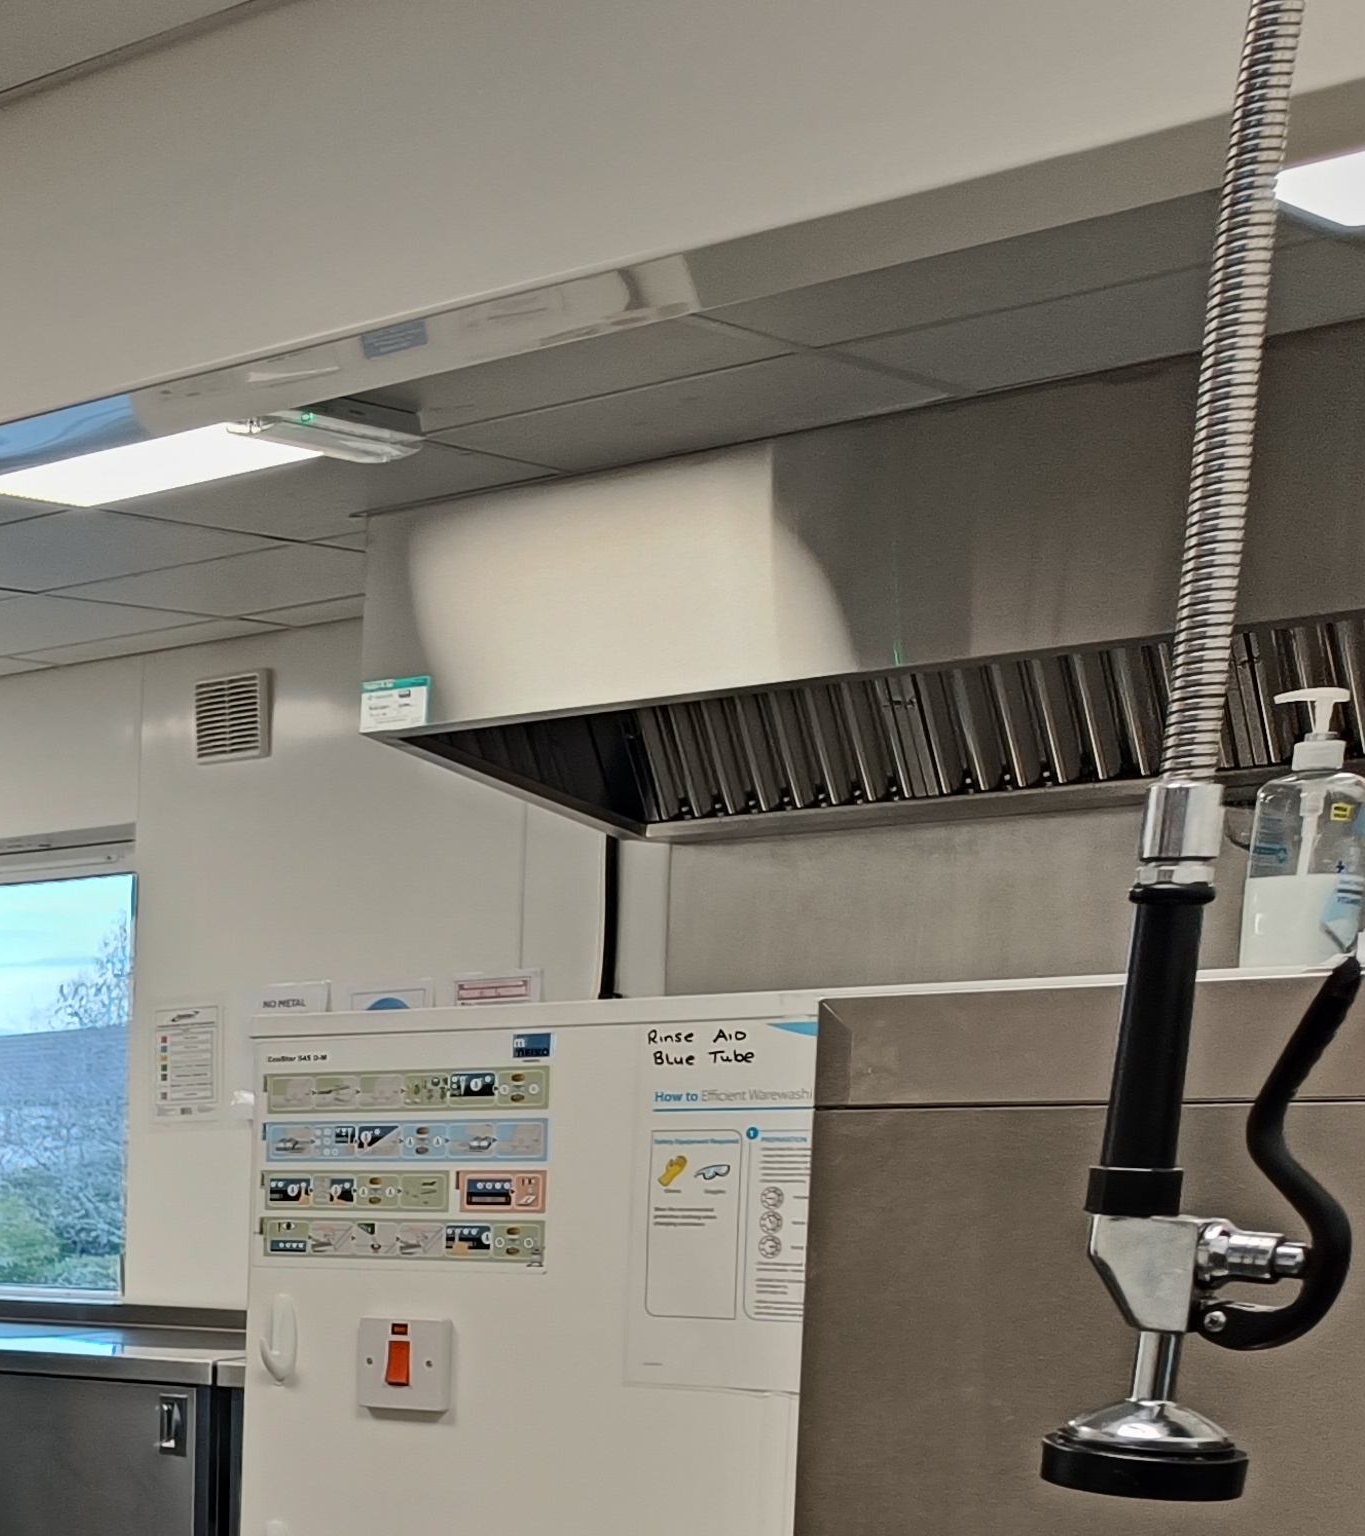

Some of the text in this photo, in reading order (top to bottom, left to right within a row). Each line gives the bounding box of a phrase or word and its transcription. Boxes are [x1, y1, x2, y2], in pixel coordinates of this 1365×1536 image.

[262, 1000, 277, 1008] NO
[647, 1029, 694, 1045] Rinse
[708, 1049, 755, 1064] Tube
[655, 1091, 683, 1102] How
[685, 1091, 699, 1102] to
[700, 1089, 747, 1102] Efficient
